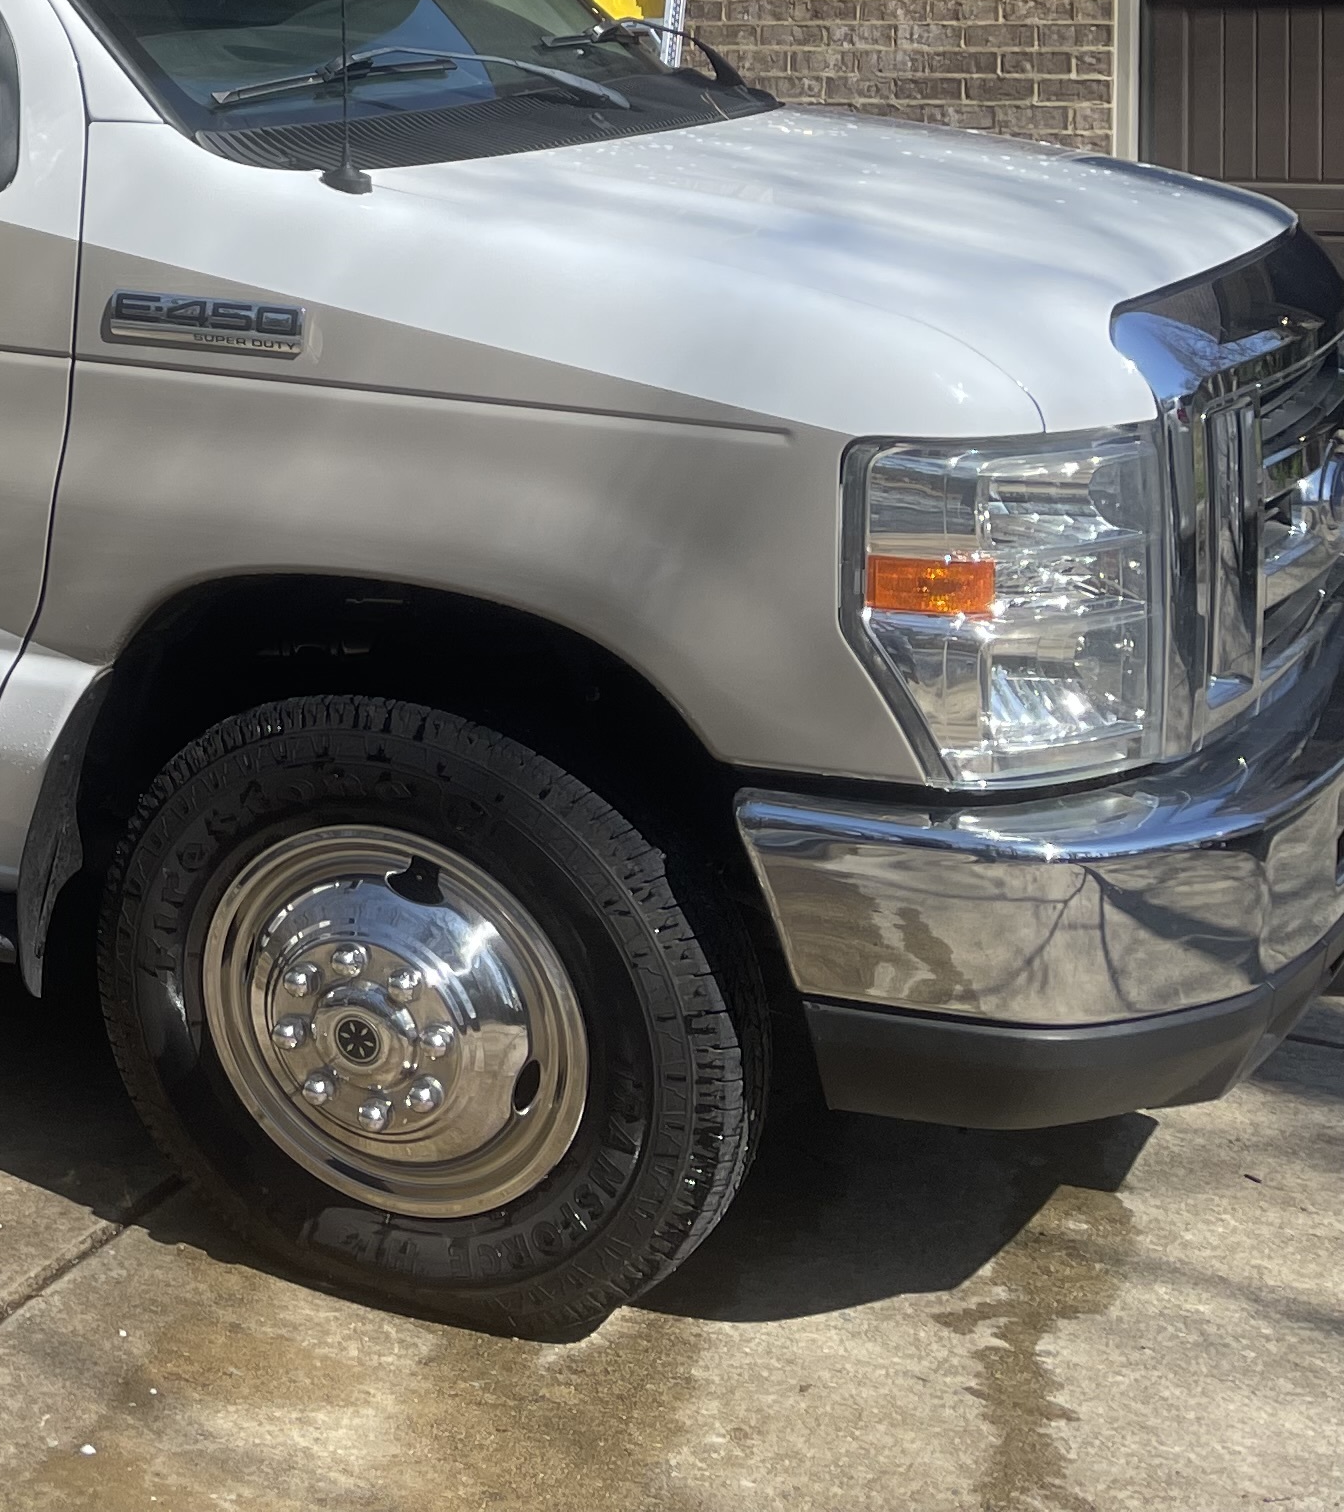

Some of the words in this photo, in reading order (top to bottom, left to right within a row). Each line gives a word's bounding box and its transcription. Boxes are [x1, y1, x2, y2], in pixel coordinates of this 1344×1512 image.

[114, 292, 299, 336] E-450
[193, 333, 247, 346] SUPER
[251, 338, 297, 351] DUTY
